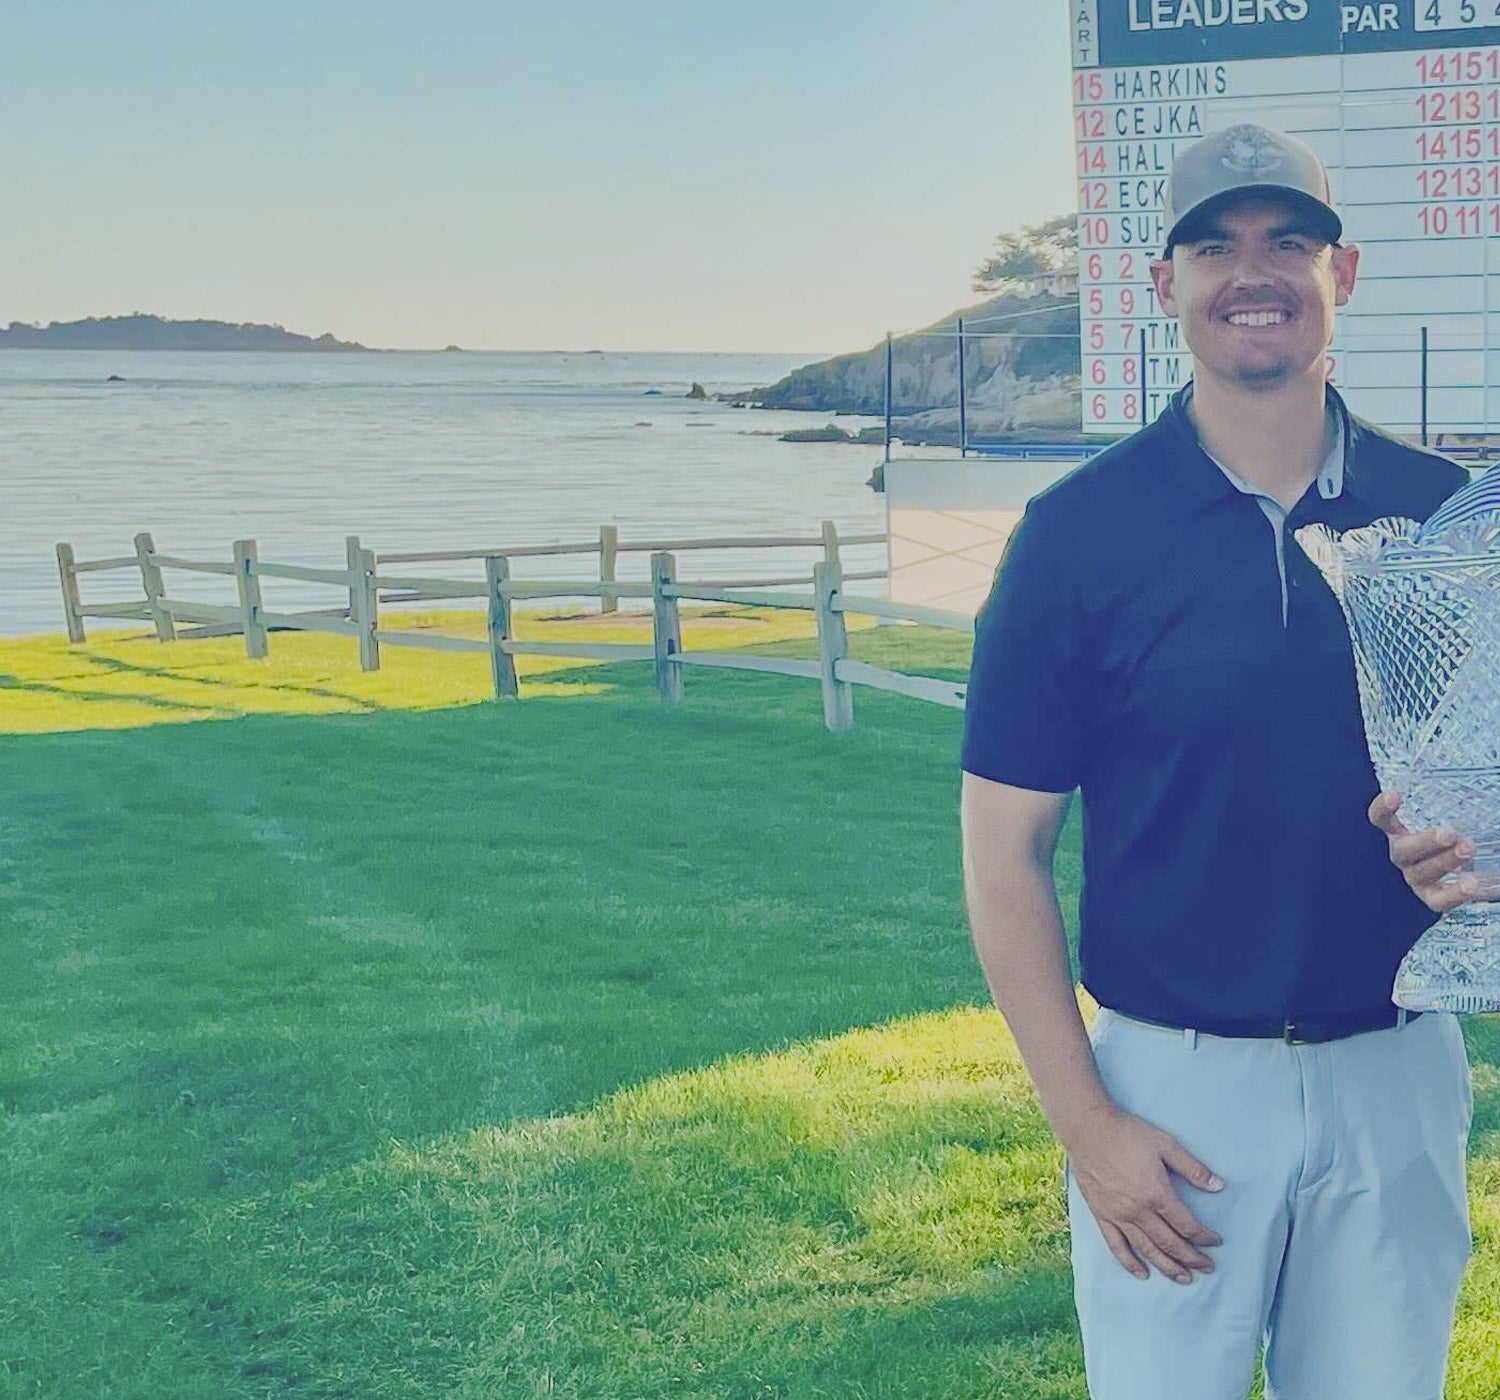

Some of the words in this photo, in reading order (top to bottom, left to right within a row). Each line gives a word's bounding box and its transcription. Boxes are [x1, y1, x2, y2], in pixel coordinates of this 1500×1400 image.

[1078, 0, 1090, 61] ART
[1128, 0, 1309, 31] LEADERS
[1341, 3, 1400, 34] PAR
[1424, 0, 1441, 26] 4
[1460, 0, 1475, 23] 5
[1074, 73, 1103, 101] 15
[1114, 66, 1227, 98] HARKINS
[1415, 54, 1446, 82] 14
[1450, 50, 1483, 80] 15
[1076, 110, 1105, 138] 12
[1115, 105, 1201, 136] CEJKA
[1415, 92, 1446, 122] 12
[1449, 90, 1480, 120] 13
[1078, 146, 1107, 173] 14
[1416, 131, 1446, 159] 14
[1450, 128, 1481, 157] 15
[1080, 182, 1107, 210] 12
[1120, 179, 1166, 208] ECK
[1417, 169, 1447, 198] 12
[1449, 167, 1482, 196] 13
[1082, 217, 1109, 244] 10
[1418, 206, 1448, 233] 10
[1454, 205, 1480, 233] 11
[1088, 254, 1102, 280] 6
[1119, 253, 1133, 280] 2
[1089, 289, 1103, 315] 5
[1121, 288, 1134, 315] 9
[1090, 324, 1104, 350] 5
[1120, 324, 1133, 349] 7
[1092, 359, 1105, 385] 6
[1123, 358, 1136, 385] 8
[1093, 394, 1106, 419] 6
[1124, 394, 1136, 419] 8
